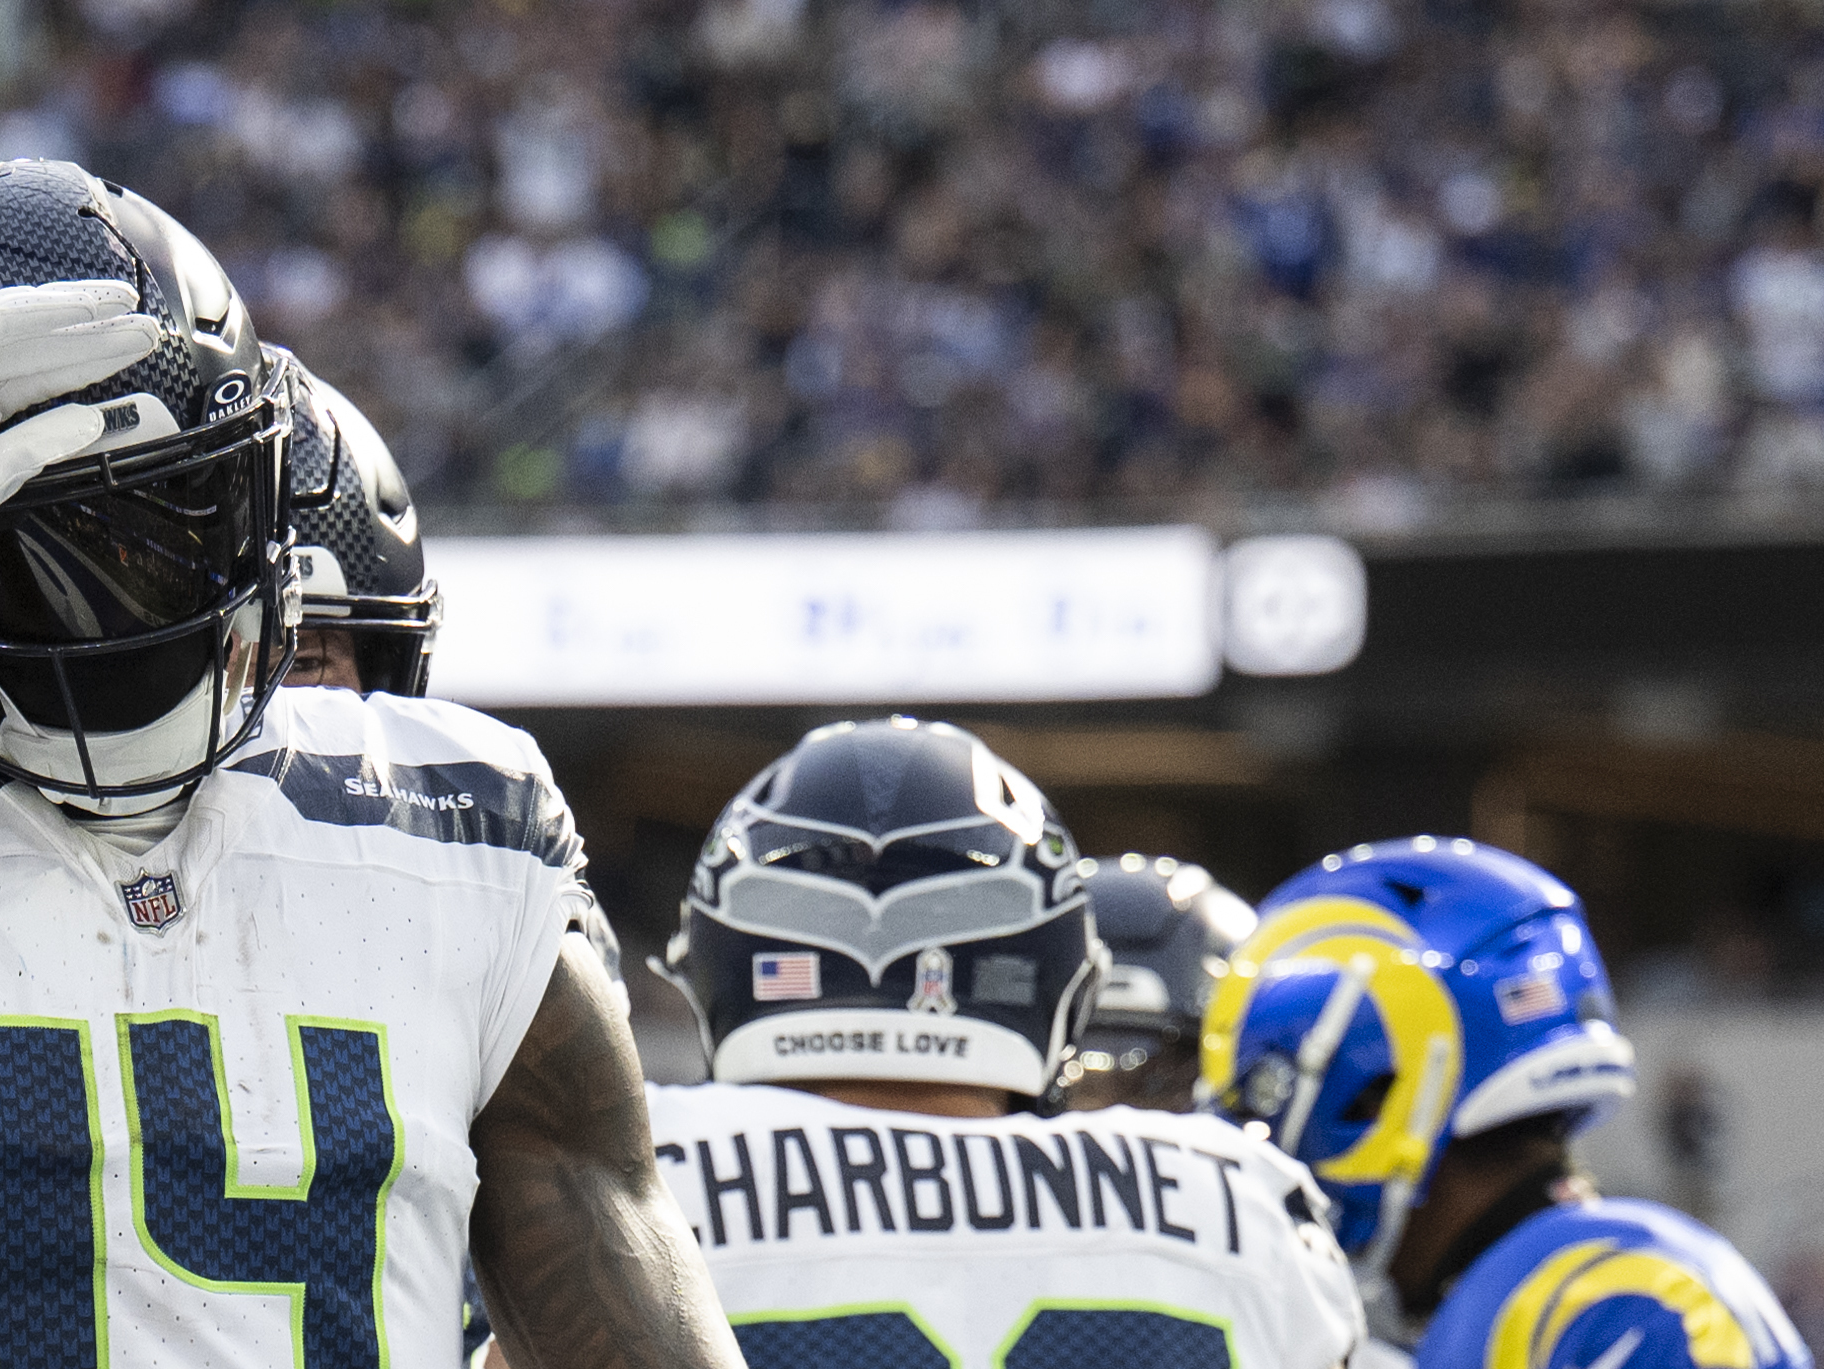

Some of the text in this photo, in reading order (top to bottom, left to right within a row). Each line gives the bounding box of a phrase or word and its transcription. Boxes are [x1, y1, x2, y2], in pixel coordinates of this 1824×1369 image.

[208, 396, 252, 422] OAKLEY
[344, 777, 475, 812] SEAHAWKS
[131, 893, 177, 924] NFL
[775, 1031, 971, 1058] CHOOSE LOVE
